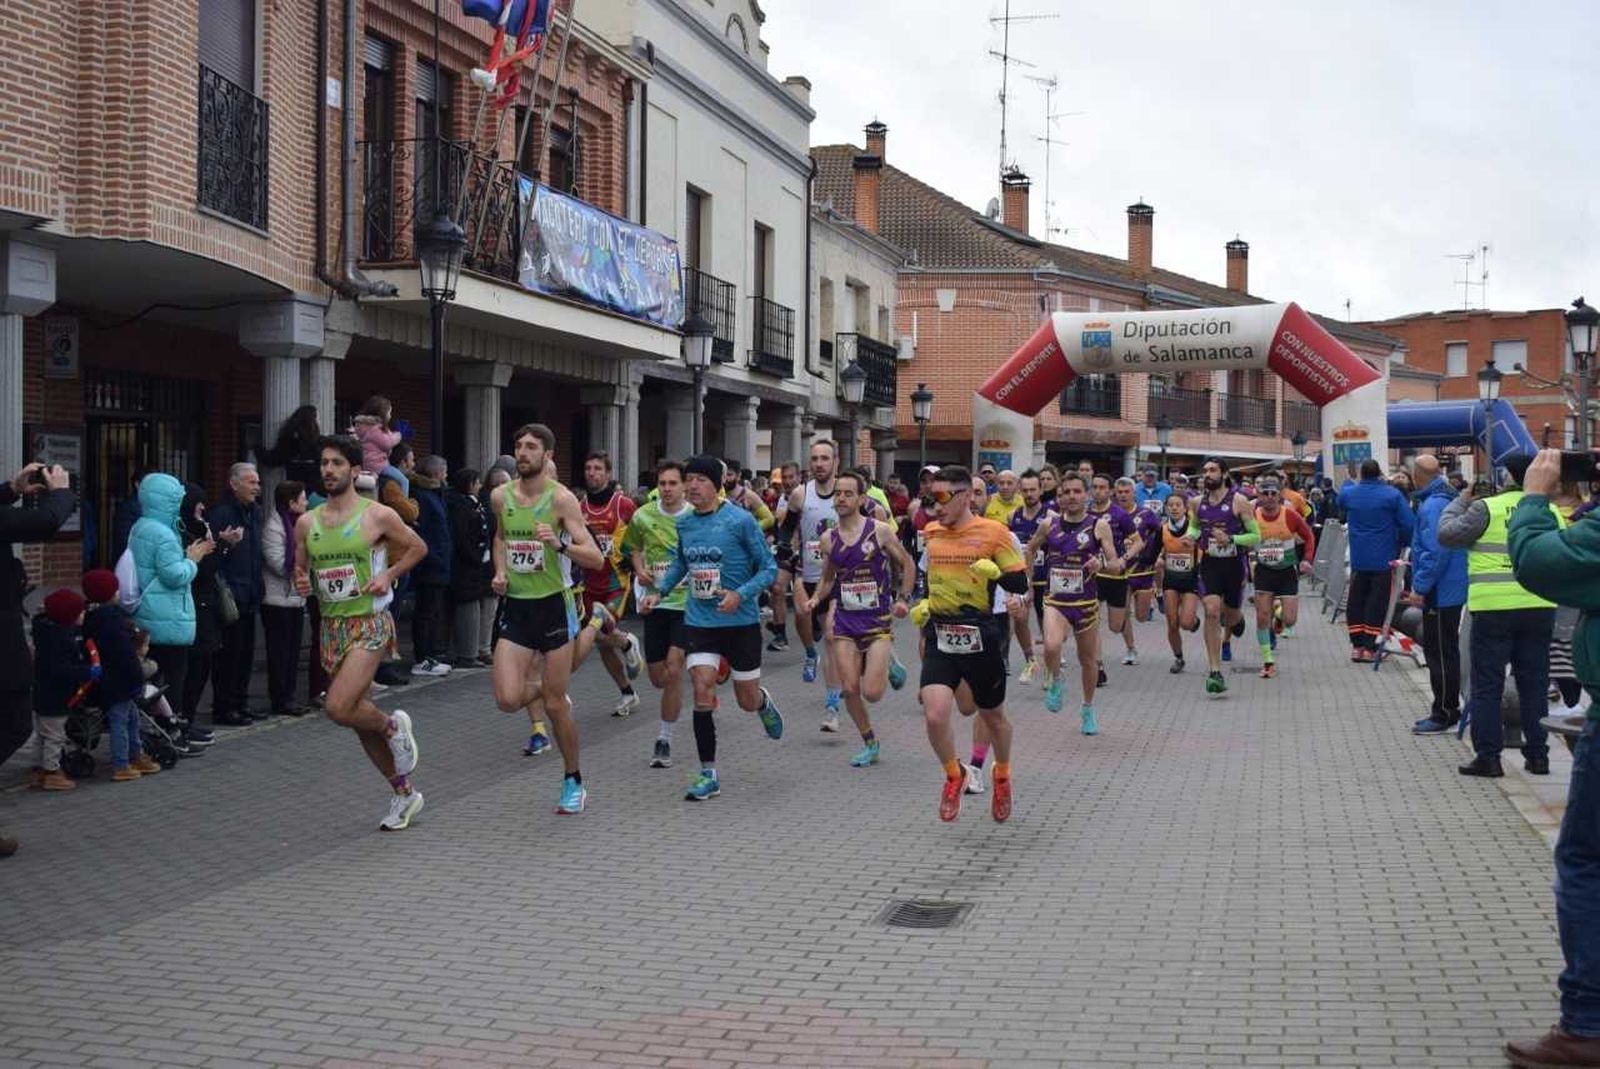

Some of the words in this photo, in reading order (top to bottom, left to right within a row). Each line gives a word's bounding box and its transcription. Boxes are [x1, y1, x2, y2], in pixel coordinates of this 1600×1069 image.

[1122, 319, 1231, 342] Diputación
[1123, 350, 1141, 363] de
[1148, 343, 1253, 362] Salamanca
[1282, 330, 1303, 349] CON
[1300, 345, 1350, 387] NUESTROS
[996, 381, 1012, 400] CON
[1020, 342, 1056, 378] DEPORTE
[1275, 344, 1336, 394] DEPORTISTAS
[511, 552, 535, 565] 276
[328, 578, 344, 594] 69
[1062, 577, 1070, 588] 2
[946, 633, 972, 646] 223
